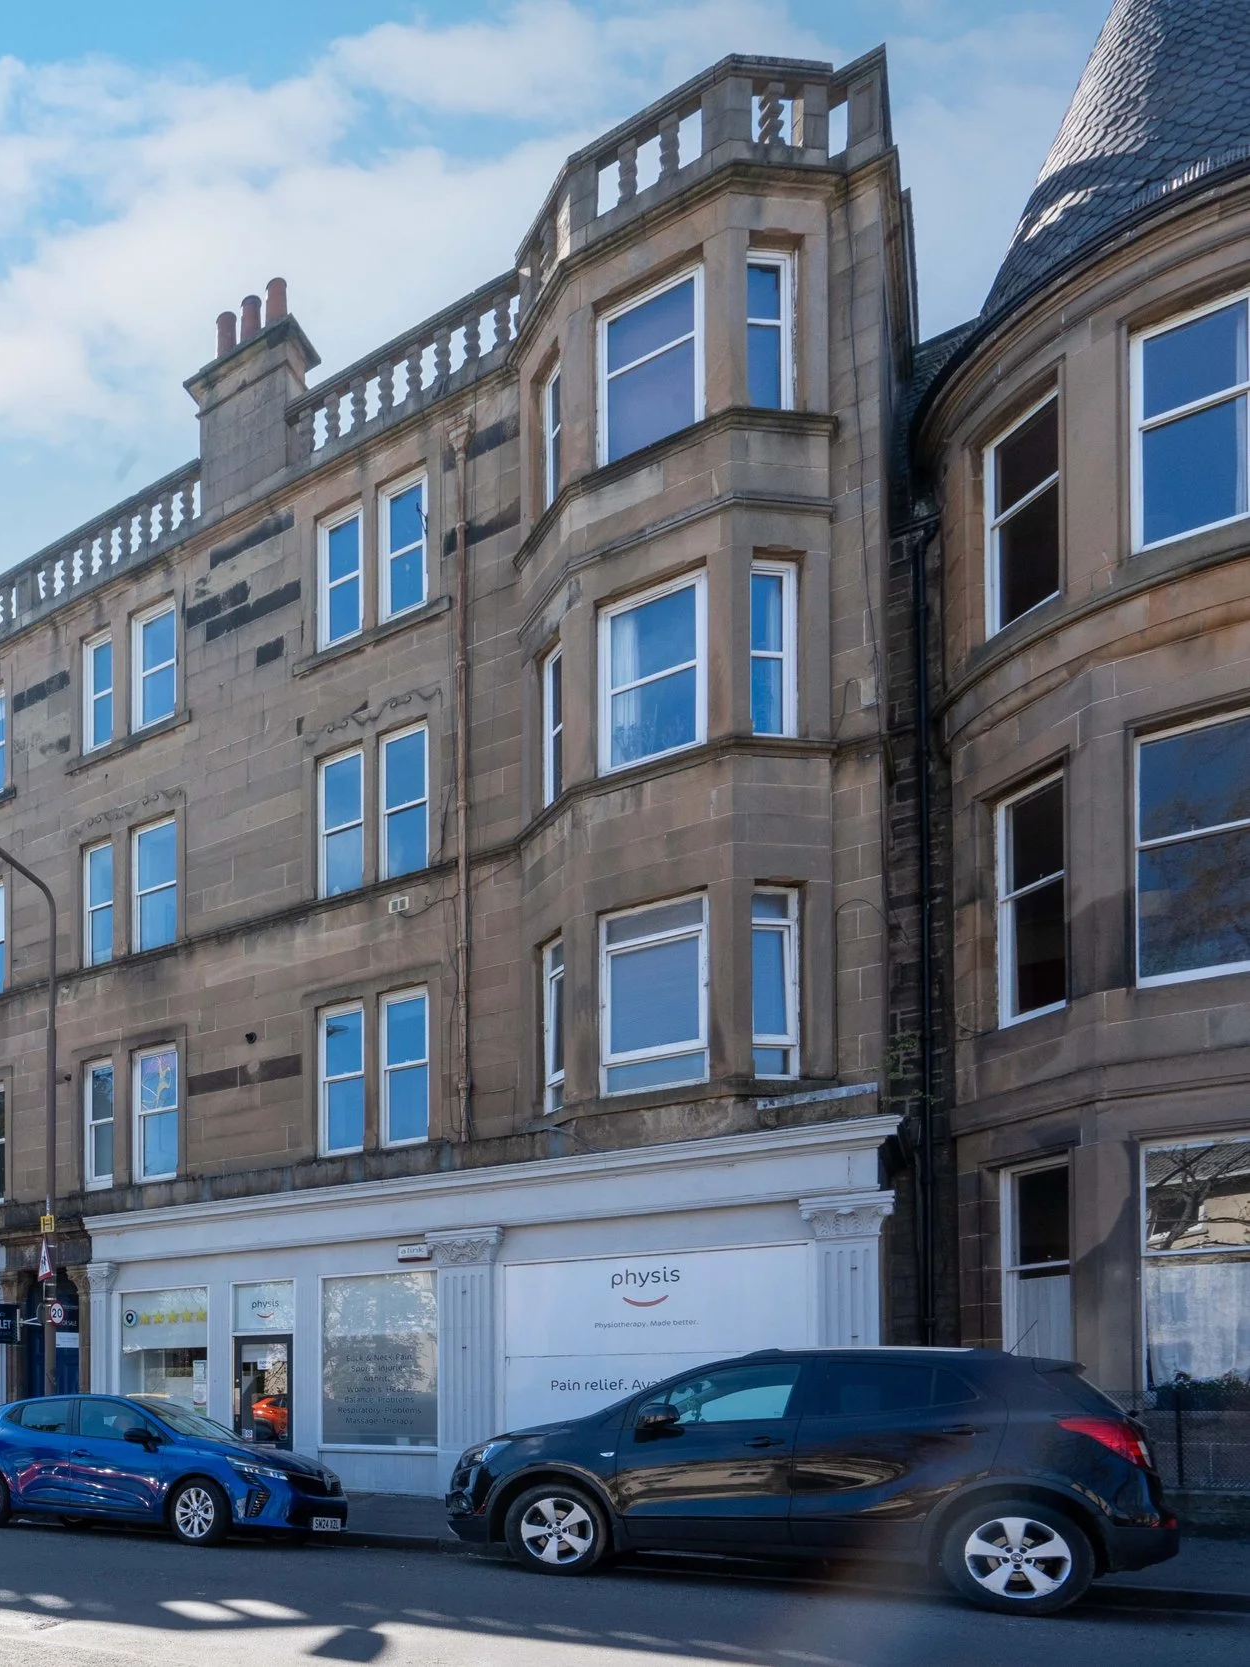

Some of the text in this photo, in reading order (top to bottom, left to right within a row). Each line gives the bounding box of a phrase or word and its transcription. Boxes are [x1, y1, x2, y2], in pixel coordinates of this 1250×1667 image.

[42, 1217, 53, 1231] H
[611, 1266, 681, 1288] physis
[251, 1299, 280, 1310] physis
[51, 1308, 62, 1318] 20
[0, 1319, 11, 1330] LET
[594, 1321, 648, 1329] Physiotherapy.
[551, 1379, 580, 1390] Pain
[584, 1379, 627, 1391] relief.
[344, 1396, 374, 1404] Balance
[337, 1406, 422, 1415] Respiratory Problems
[345, 1417, 378, 1426] Massage
